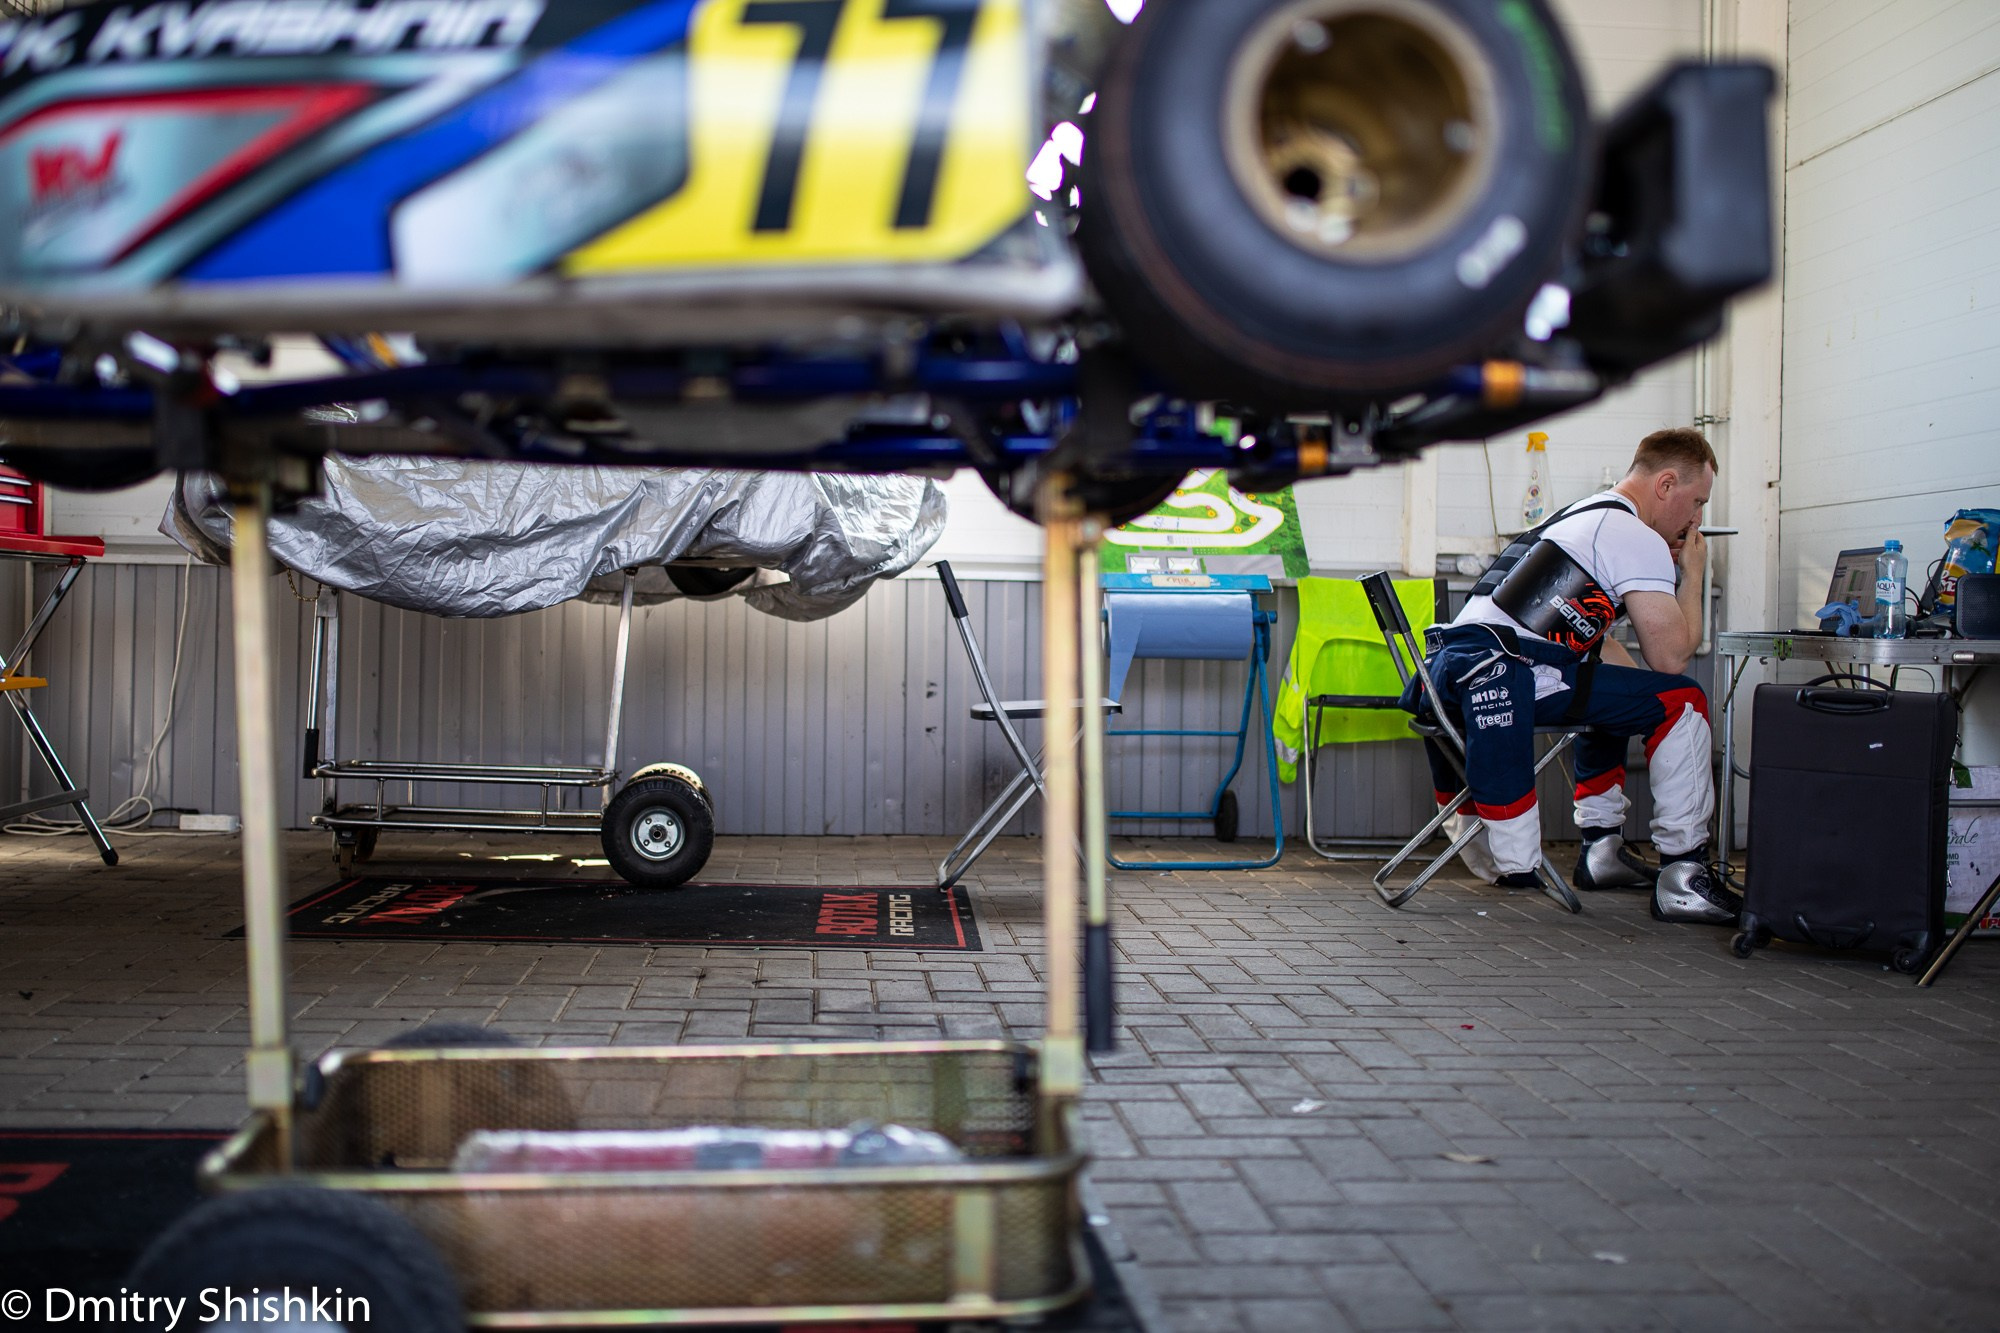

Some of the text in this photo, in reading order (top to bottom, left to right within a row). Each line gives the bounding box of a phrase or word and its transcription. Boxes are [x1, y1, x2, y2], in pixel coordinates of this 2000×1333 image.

[1549, 594, 1597, 638] BENGIO
[1473, 700, 1513, 712] RACING
[1476, 711, 1514, 729] freem
[815, 892, 879, 935] ROTAX
[888, 894, 915, 936] RACING
